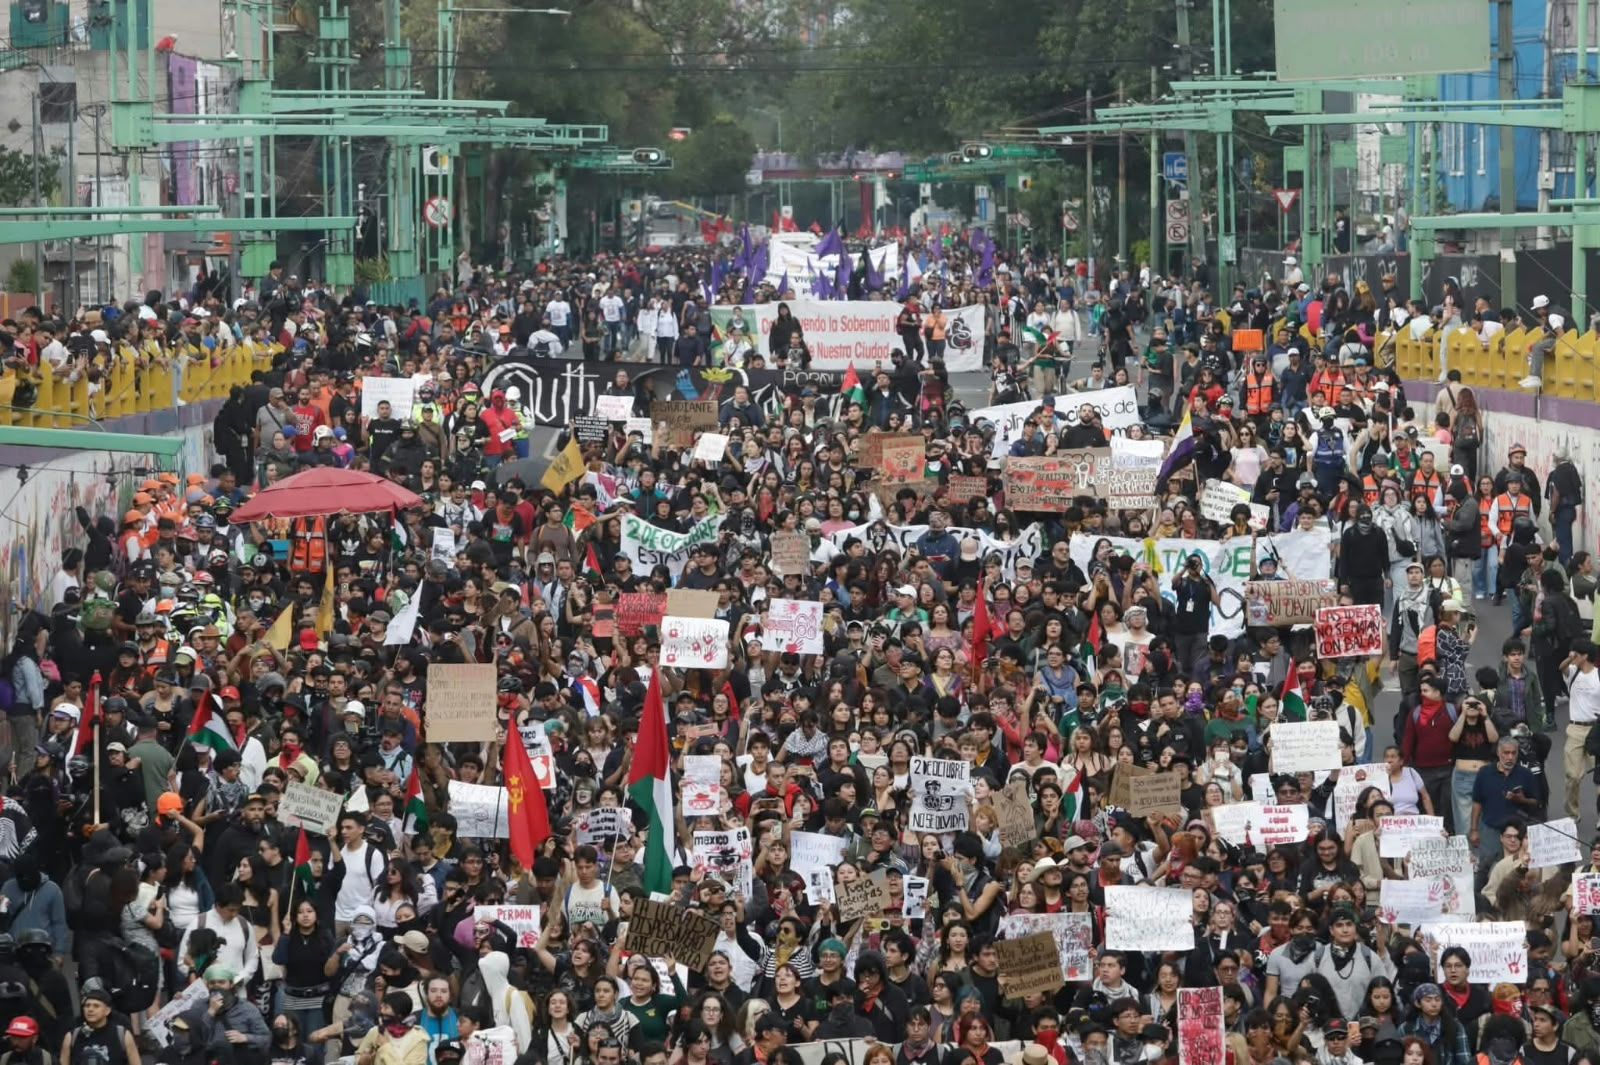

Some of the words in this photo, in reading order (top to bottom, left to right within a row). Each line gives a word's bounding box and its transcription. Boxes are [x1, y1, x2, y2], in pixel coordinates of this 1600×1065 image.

[829, 314, 838, 332] la
[840, 314, 890, 333] Soberanía
[817, 342, 852, 359] Nuestra
[854, 341, 890, 360] Ciudad
[1114, 399, 1136, 415] de
[627, 518, 640, 540] 2
[641, 524, 661, 551] DE
[1270, 599, 1281, 617] NI
[1318, 609, 1341, 624] LAS
[1344, 606, 1380, 620] IDEAS
[1317, 623, 1334, 638] NO
[1336, 621, 1352, 637] SE
[1352, 619, 1381, 635] MATAN
[1320, 638, 1342, 655] CON
[1344, 633, 1381, 651] BALAS
[914, 759, 922, 775] 2
[923, 760, 932, 776] DE
[932, 760, 966, 780] OCTUBRE
[913, 813, 925, 828] NO
[926, 813, 934, 829] SE
[936, 812, 966, 830] OLVIDA
[695, 835, 729, 846] mexico
[843, 879, 874, 897] Fuera
[497, 908, 532, 921] PERDON
